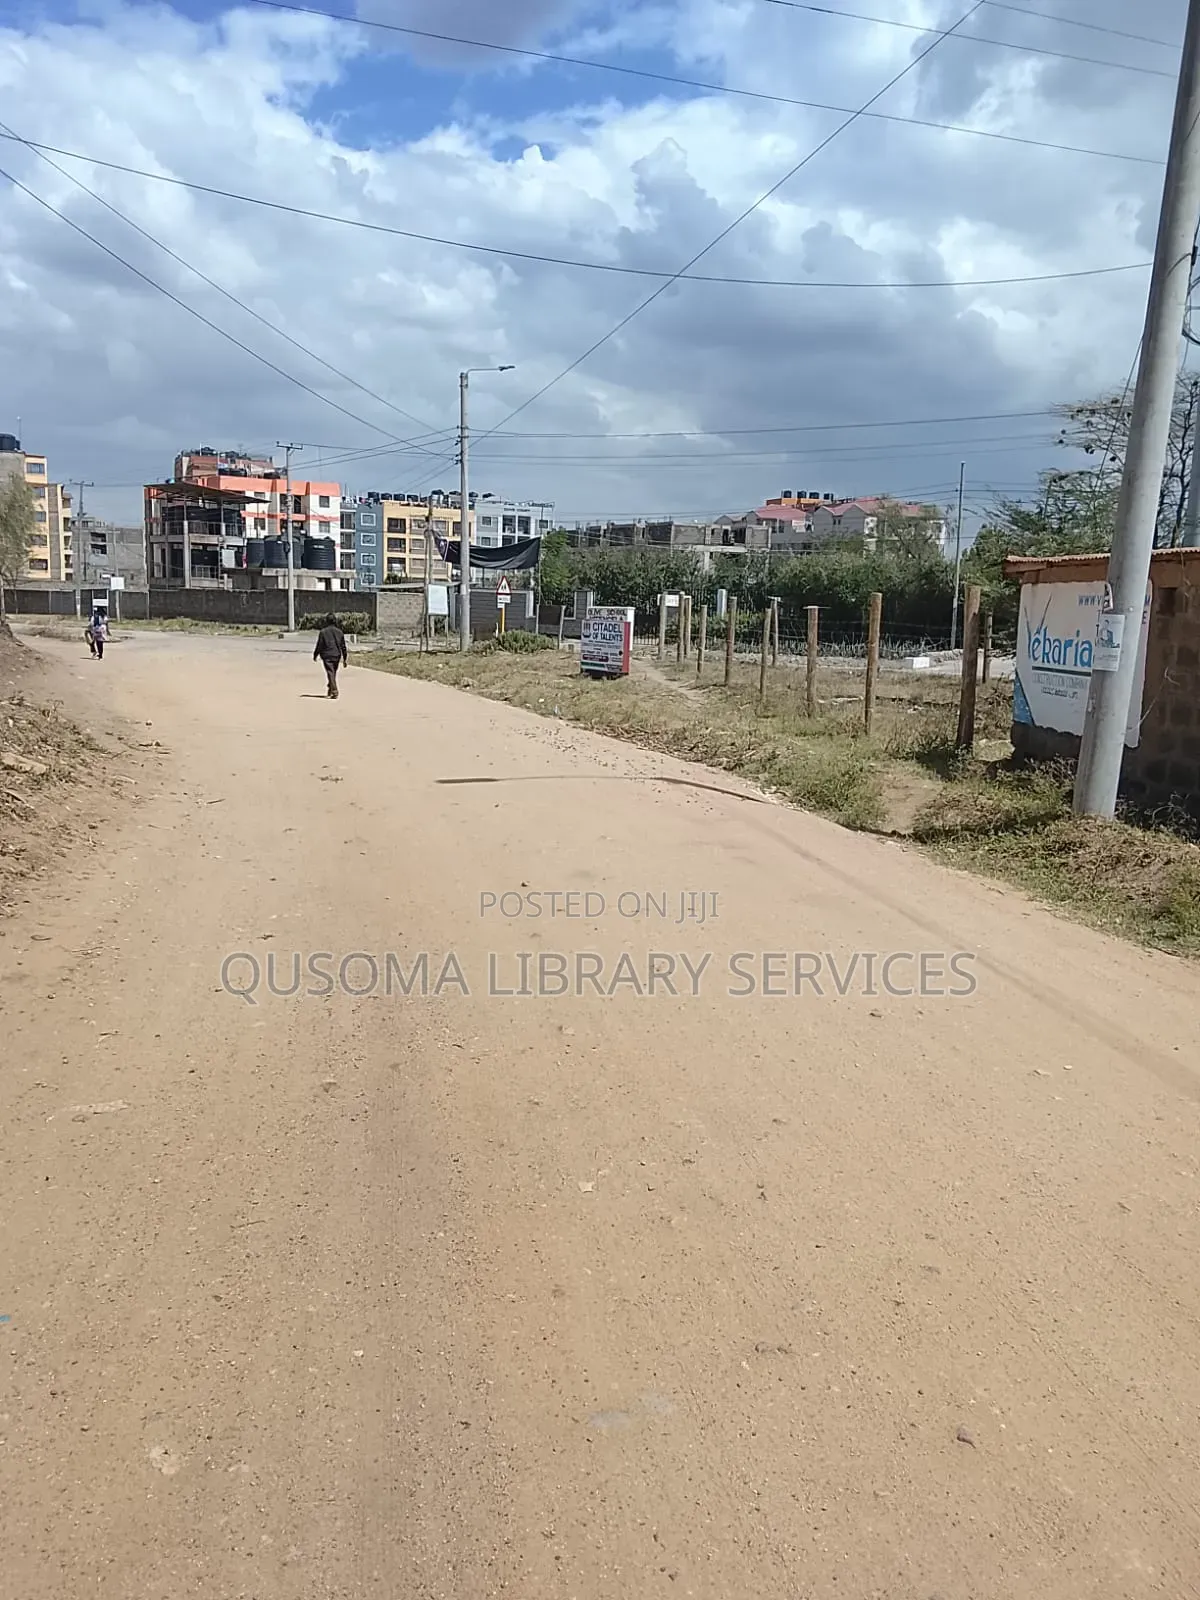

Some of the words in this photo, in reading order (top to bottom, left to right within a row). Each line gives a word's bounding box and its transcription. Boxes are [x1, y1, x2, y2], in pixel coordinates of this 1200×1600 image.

[592, 622, 622, 633] CITADEL
[592, 632, 599, 640] OF
[600, 632, 624, 642] TALENTS
